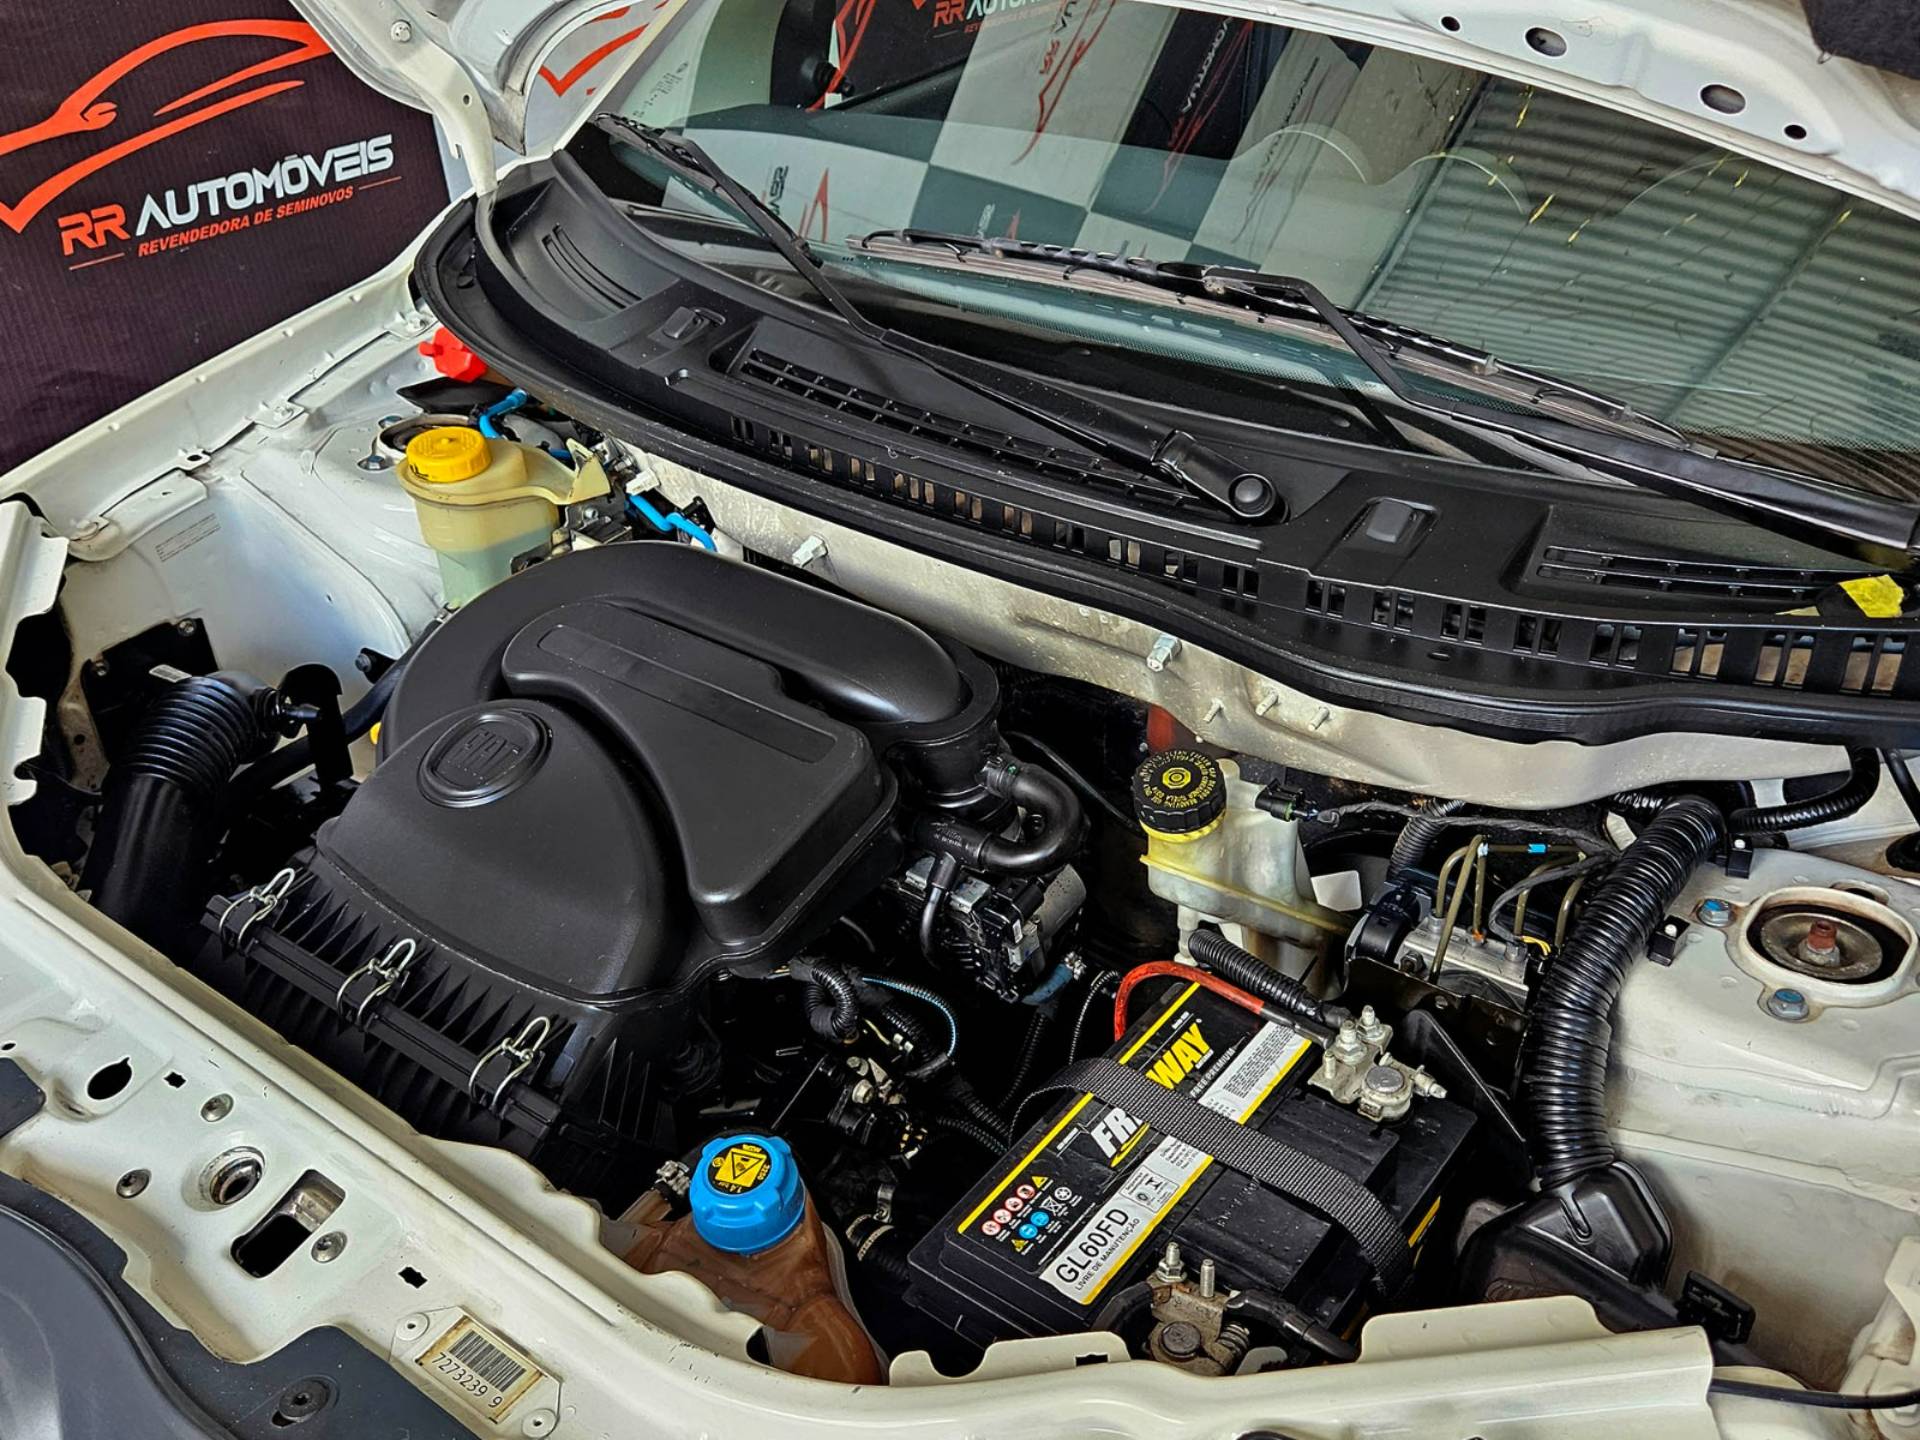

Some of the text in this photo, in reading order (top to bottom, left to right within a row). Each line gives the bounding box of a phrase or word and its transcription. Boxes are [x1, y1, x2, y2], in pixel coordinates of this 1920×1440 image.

[933, 0, 965, 28] RR
[58, 204, 131, 256] RR
[138, 186, 354, 257] REVENDEDORA DE SEMINOVOS
[1091, 1107, 1143, 1158] FR
[1145, 1023, 1210, 1090] WAY
[1205, 1047, 1236, 1080] PREMIUM
[1055, 1209, 1129, 1283] GL60FD
[1075, 1218, 1140, 1291] LIVRE DE MANUTENÇÃO
[431, 1352, 503, 1409] 7273239 9
